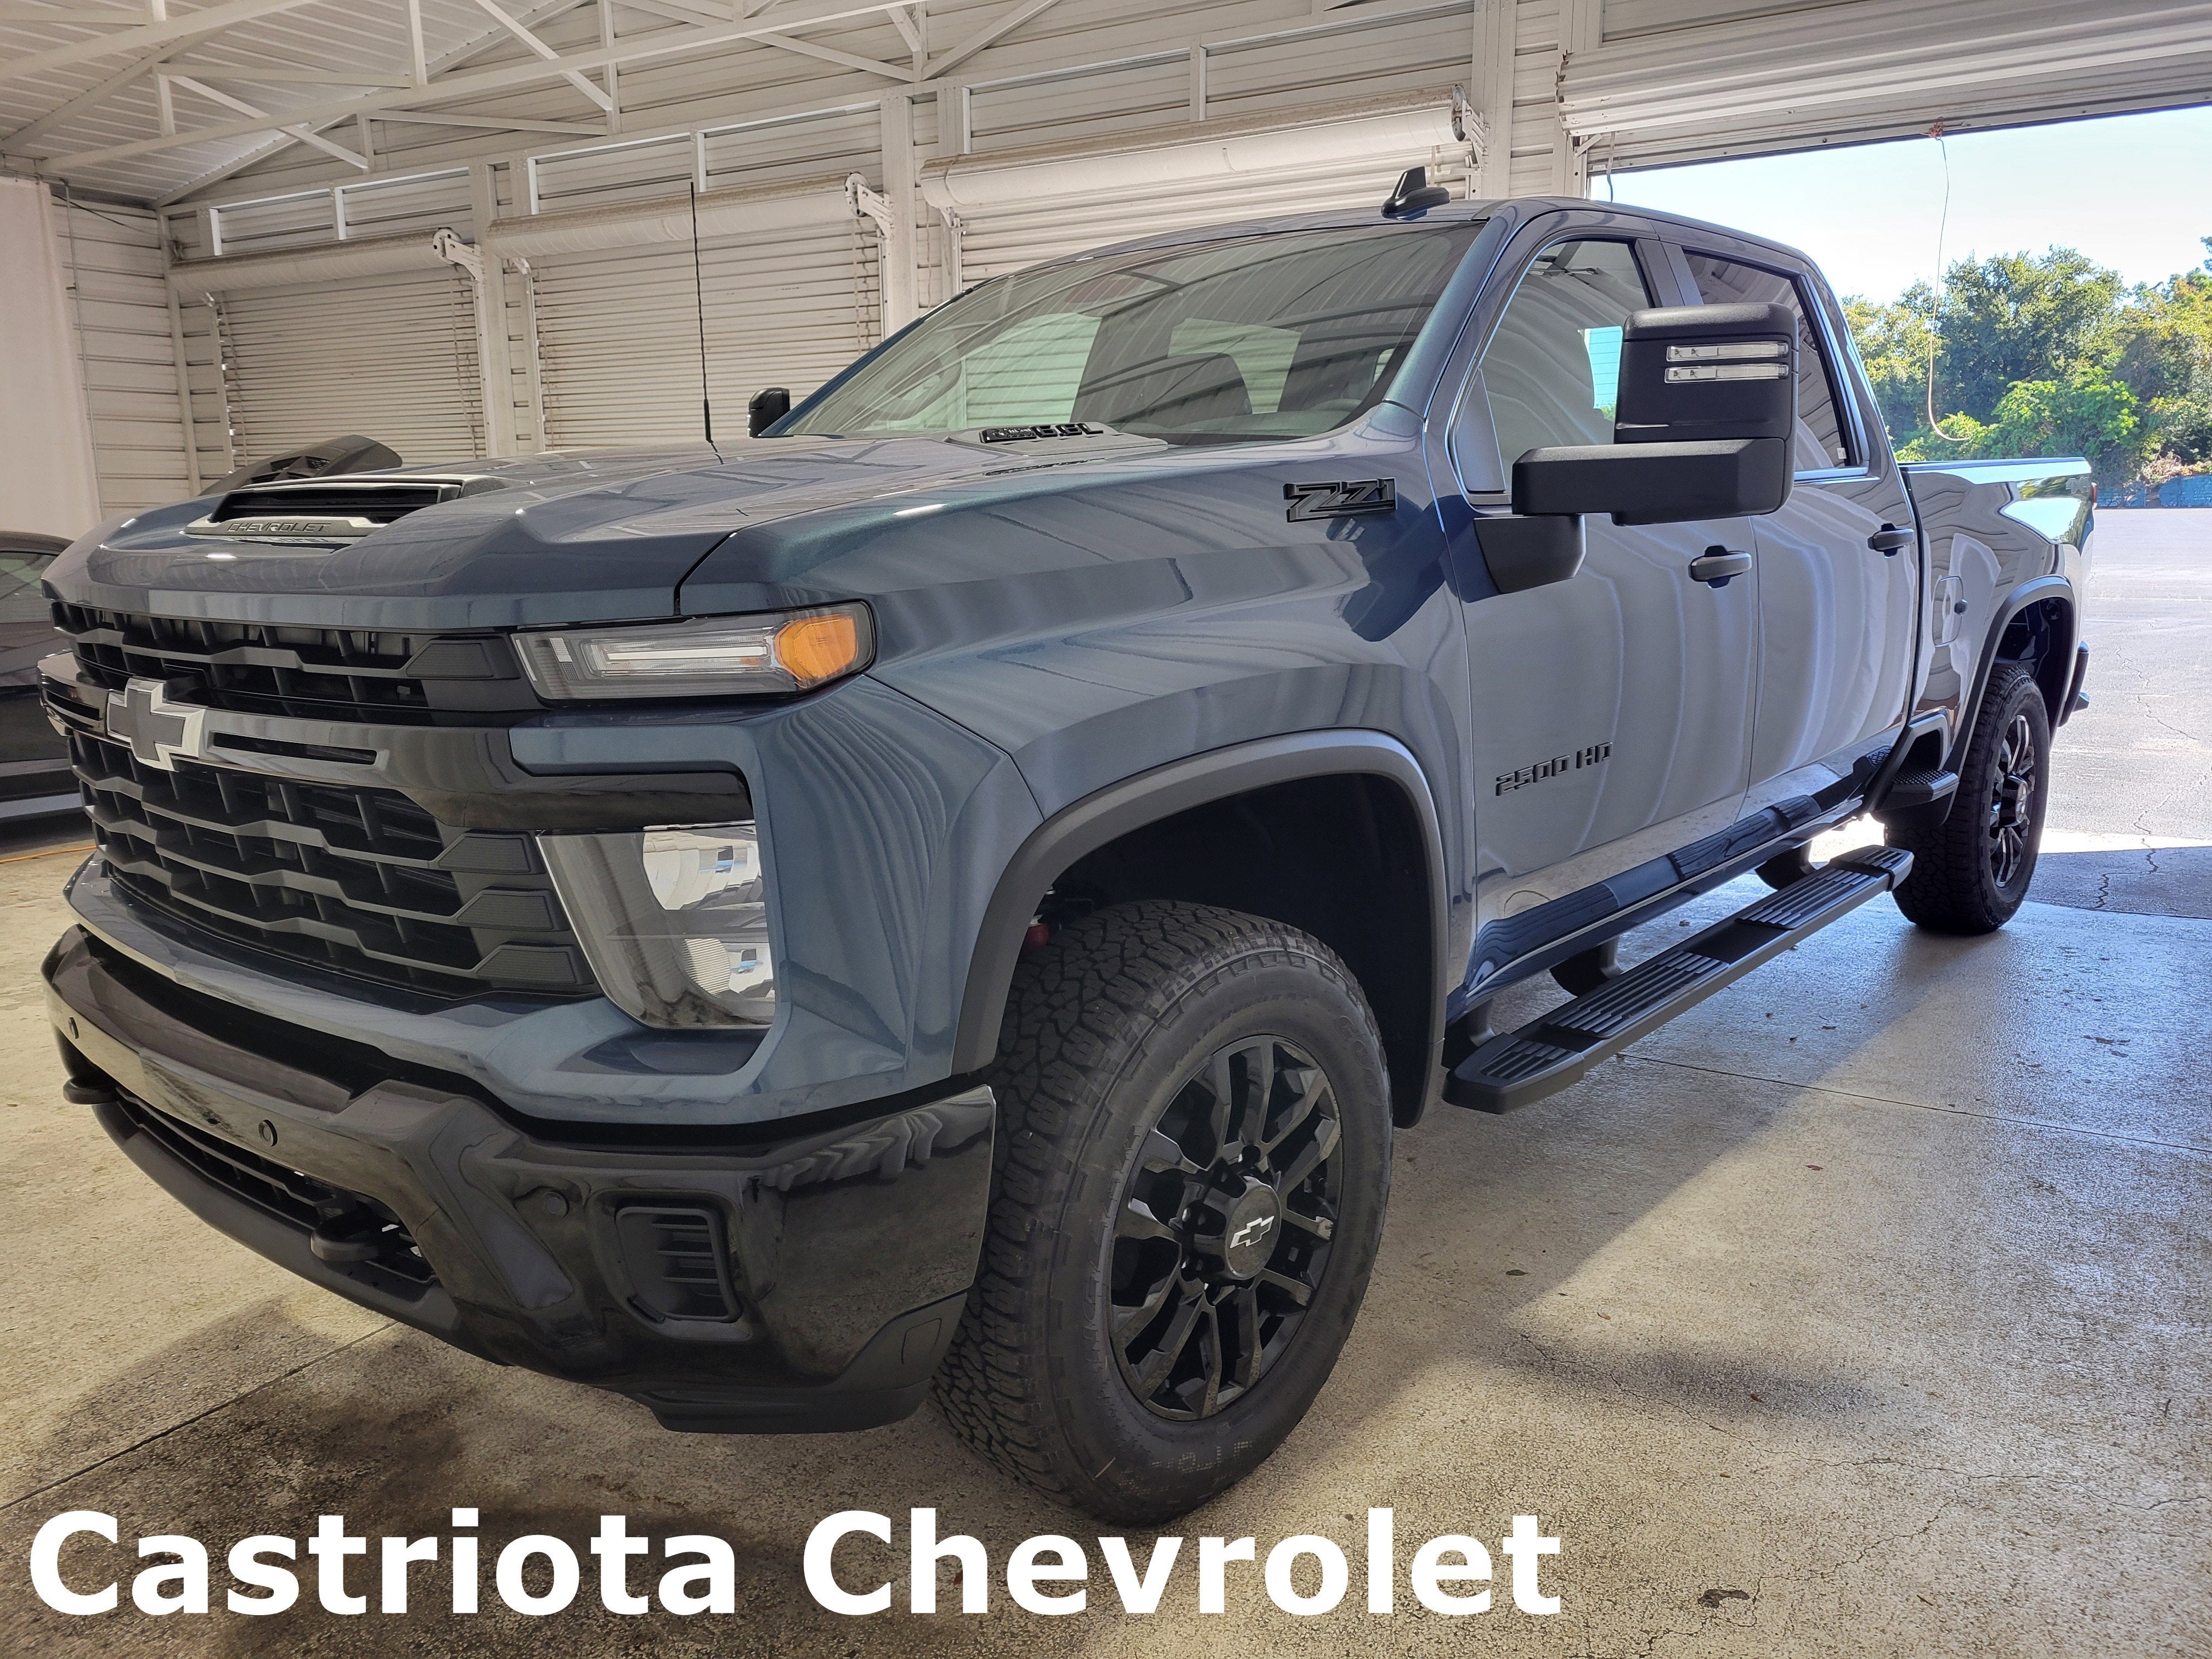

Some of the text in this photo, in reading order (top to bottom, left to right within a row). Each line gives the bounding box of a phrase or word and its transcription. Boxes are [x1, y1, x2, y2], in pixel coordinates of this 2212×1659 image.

[1283, 476, 1398, 523] Z71
[226, 522, 331, 533] CHEVROLET
[1496, 742, 1613, 796] 2500 HD
